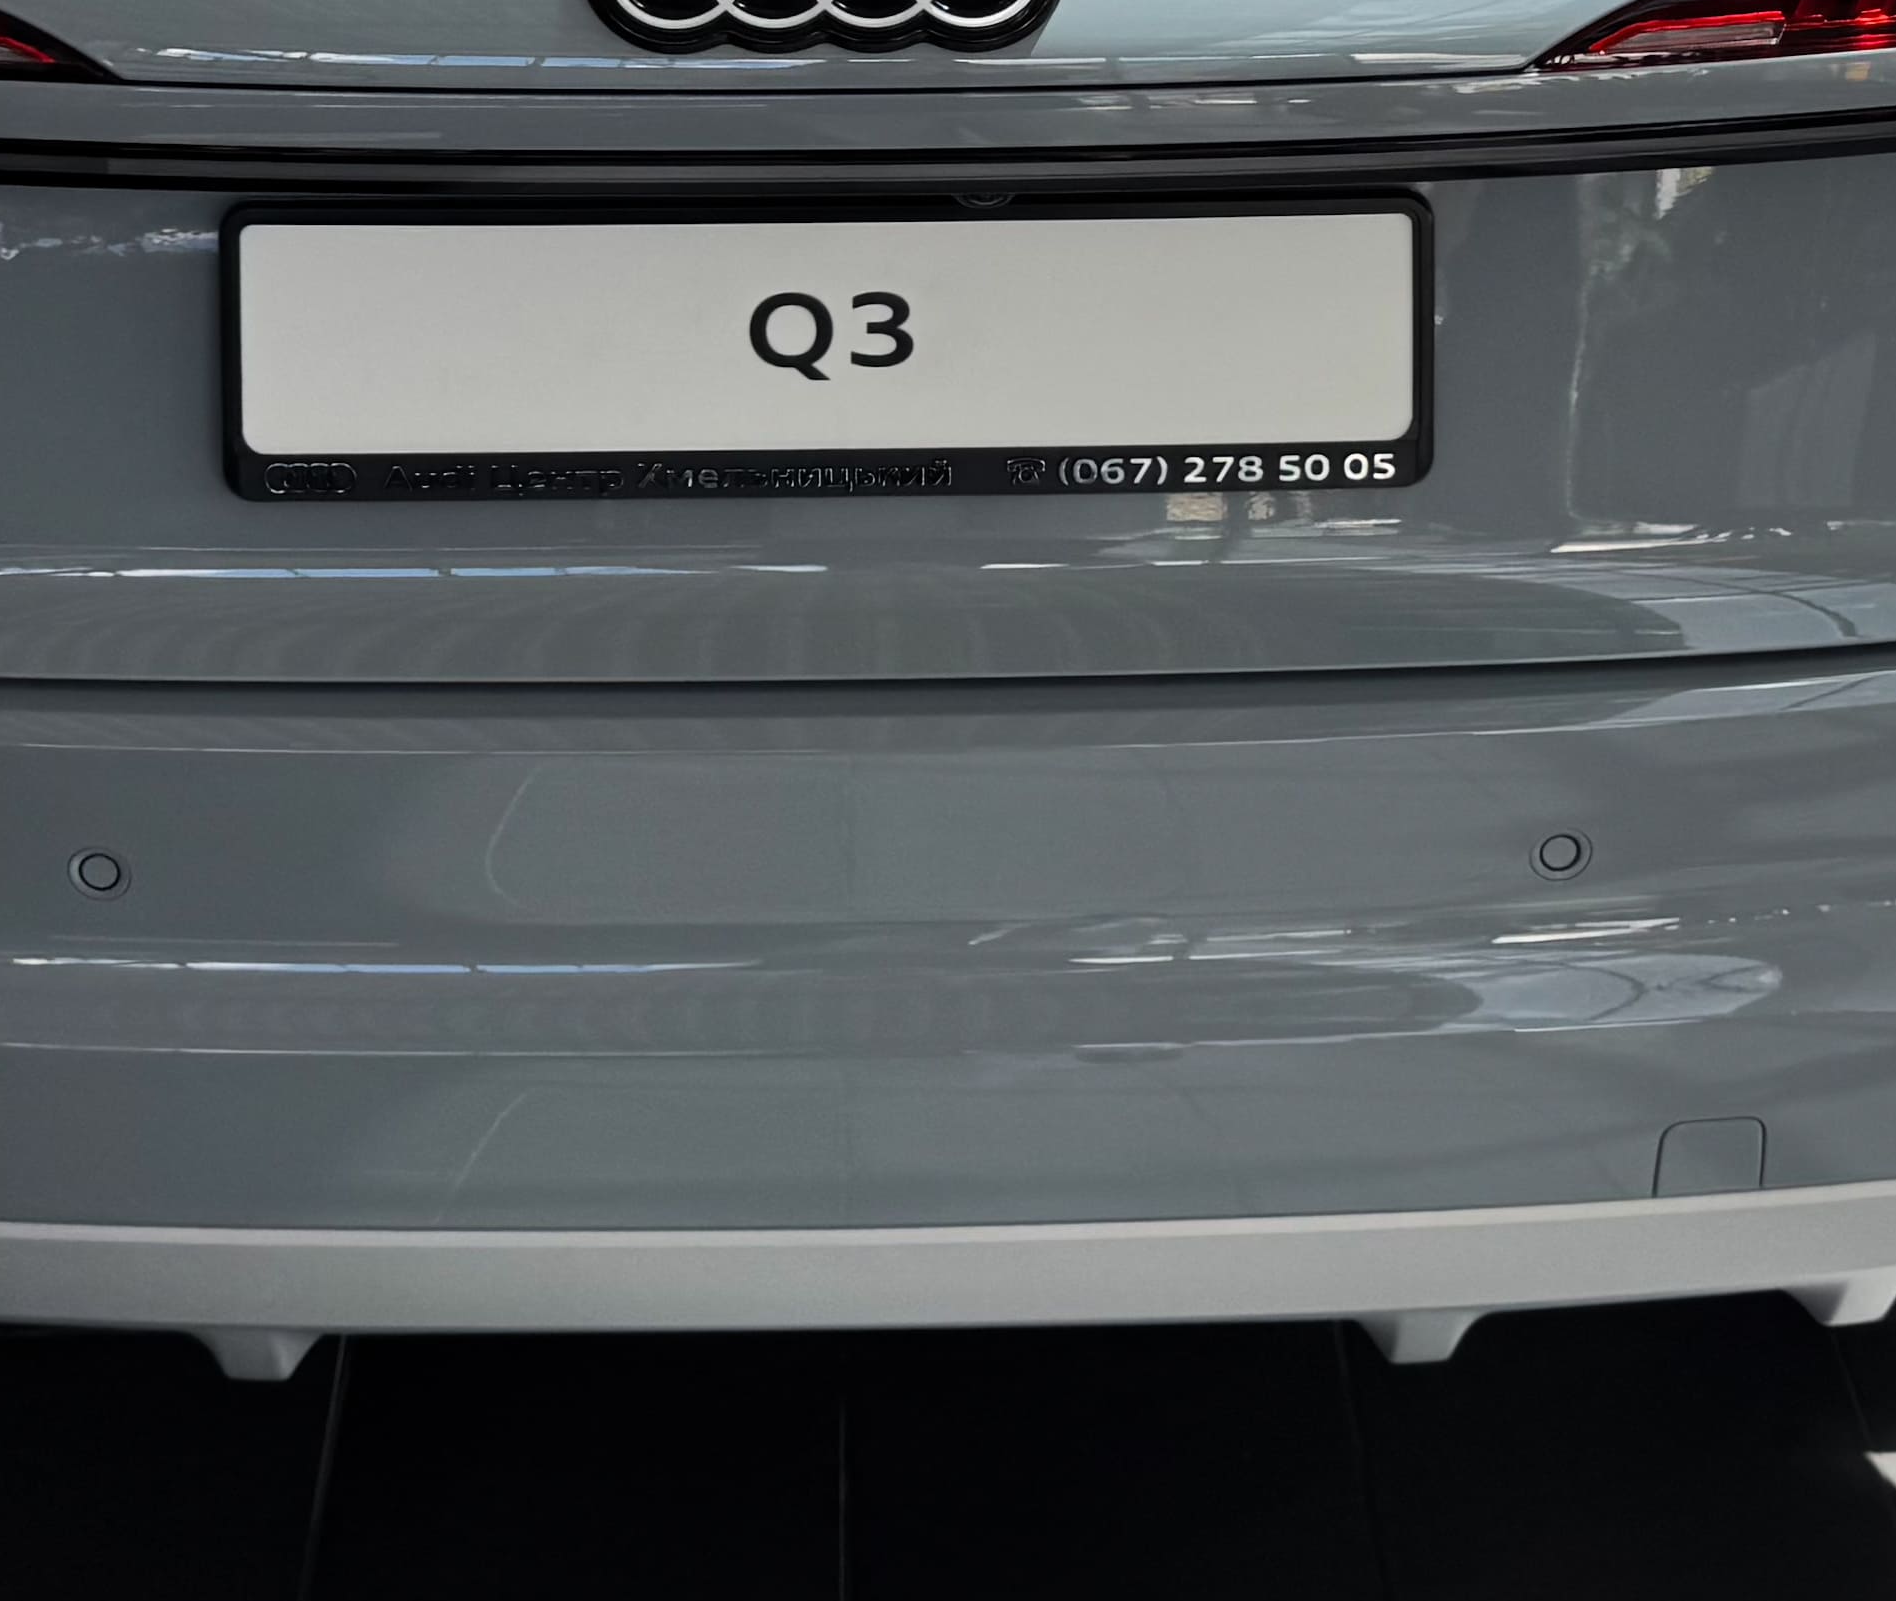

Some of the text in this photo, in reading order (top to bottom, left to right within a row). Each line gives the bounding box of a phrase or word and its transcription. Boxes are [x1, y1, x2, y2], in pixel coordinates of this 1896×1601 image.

[749, 290, 915, 382] Q3
[1058, 455, 1170, 487] (067)
[1182, 455, 1264, 484] 278
[1278, 453, 1331, 482] 50
[1342, 452, 1397, 481] 05
